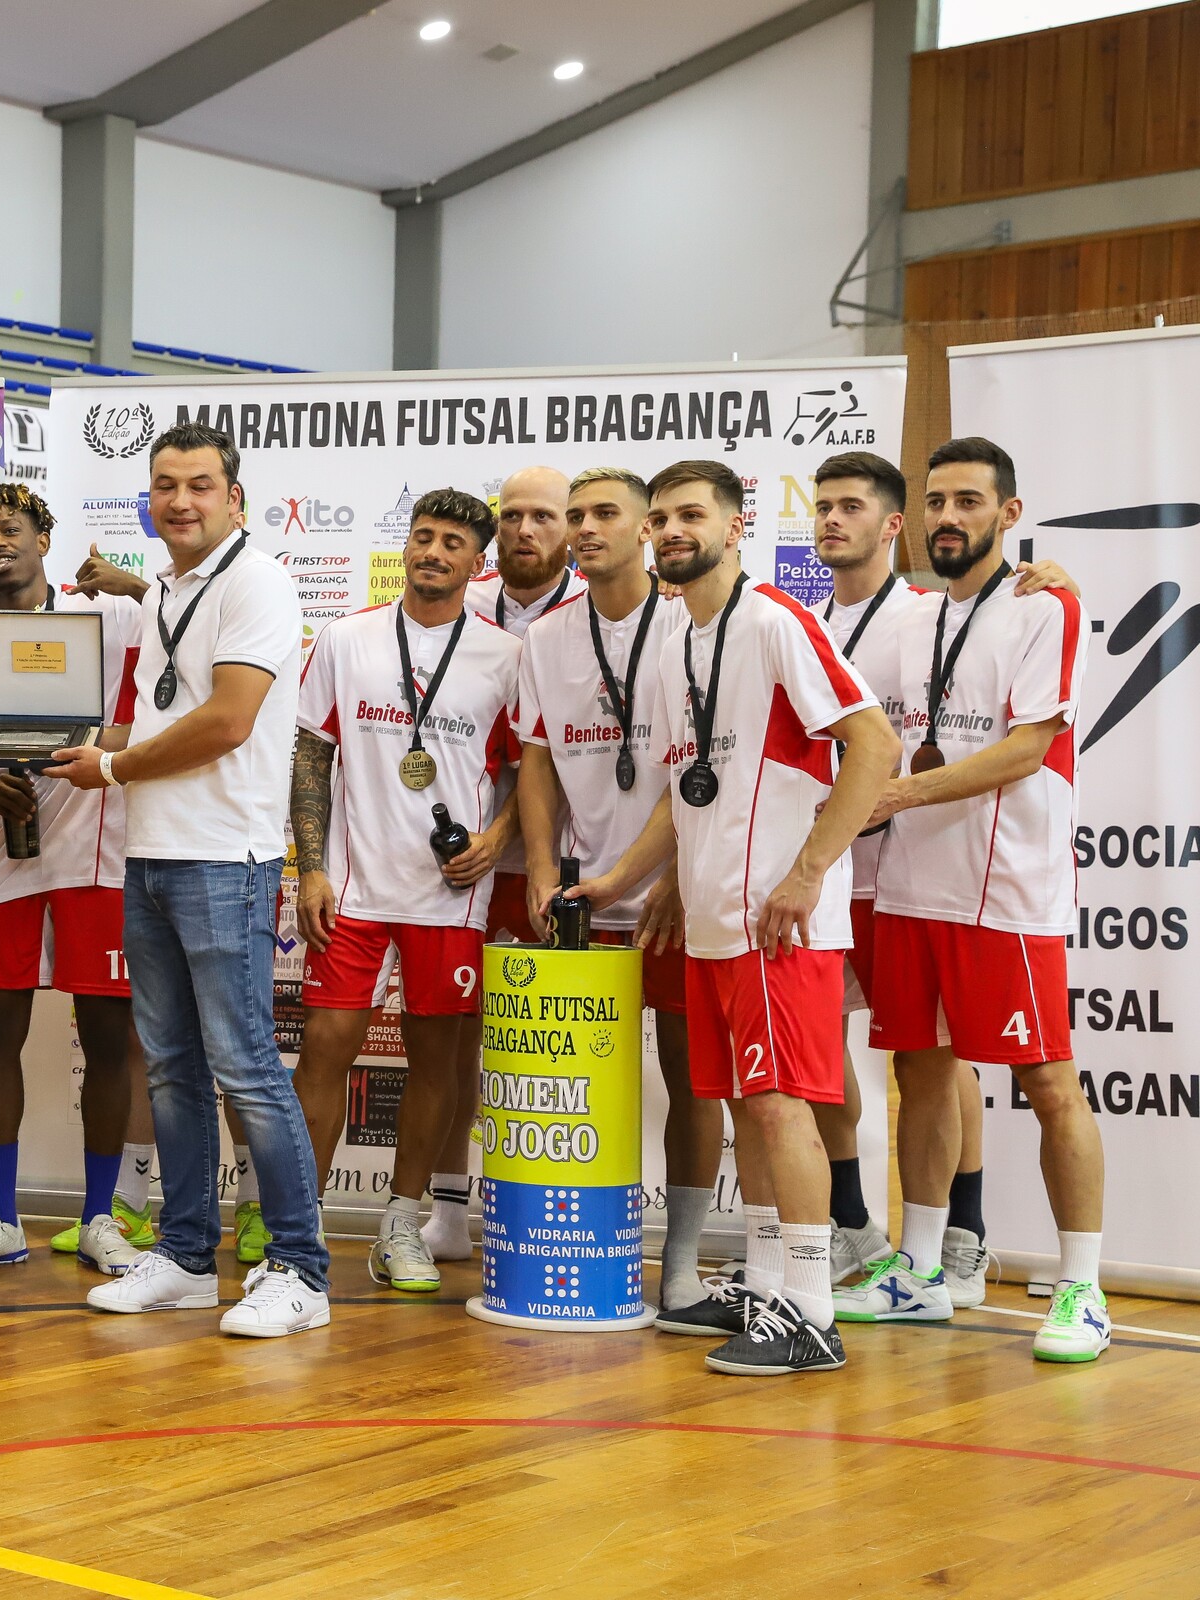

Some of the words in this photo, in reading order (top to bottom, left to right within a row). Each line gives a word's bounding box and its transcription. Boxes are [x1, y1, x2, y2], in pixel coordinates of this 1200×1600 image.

[396, 397, 536, 446] FUTSAL
[545, 390, 773, 451] BRAGANÇA
[102, 425, 131, 440] Edição
[825, 428, 876, 446] A.A.F.B
[778, 562, 833, 579] Peixo
[299, 576, 348, 586] BRAGANÇA
[371, 576, 378, 588] O
[779, 579, 811, 588] Agência
[298, 591, 349, 600] IRSTSTOP
[792, 589, 808, 598] 273
[811, 589, 829, 598] 328
[302, 610, 346, 619] RAGANÇA
[356, 700, 414, 726] Benites
[423, 715, 476, 738] orneiro
[564, 723, 622, 744] Benites
[412, 760, 433, 768] LUGAR
[1066, 906, 1189, 951] IGOS
[453, 965, 477, 998] 9
[539, 996, 619, 1021] FUTSAL
[367, 1025, 401, 1034] ORDES
[1001, 1010, 1031, 1046] 4
[369, 1043, 384, 1051] 273
[386, 1044, 400, 1052] 331
[484, 1025, 576, 1063] BRAGANÇA
[744, 1043, 766, 1081] 2
[361, 1127, 383, 1135] Miguel
[358, 1136, 377, 1144] 933
[502, 1120, 599, 1163] JOGO
[528, 1227, 596, 1242] VIDRARIA
[519, 1243, 605, 1258] BRIGANTINA
[792, 1254, 826, 1262] umbro
[527, 1302, 596, 1317] VIDRARIA
